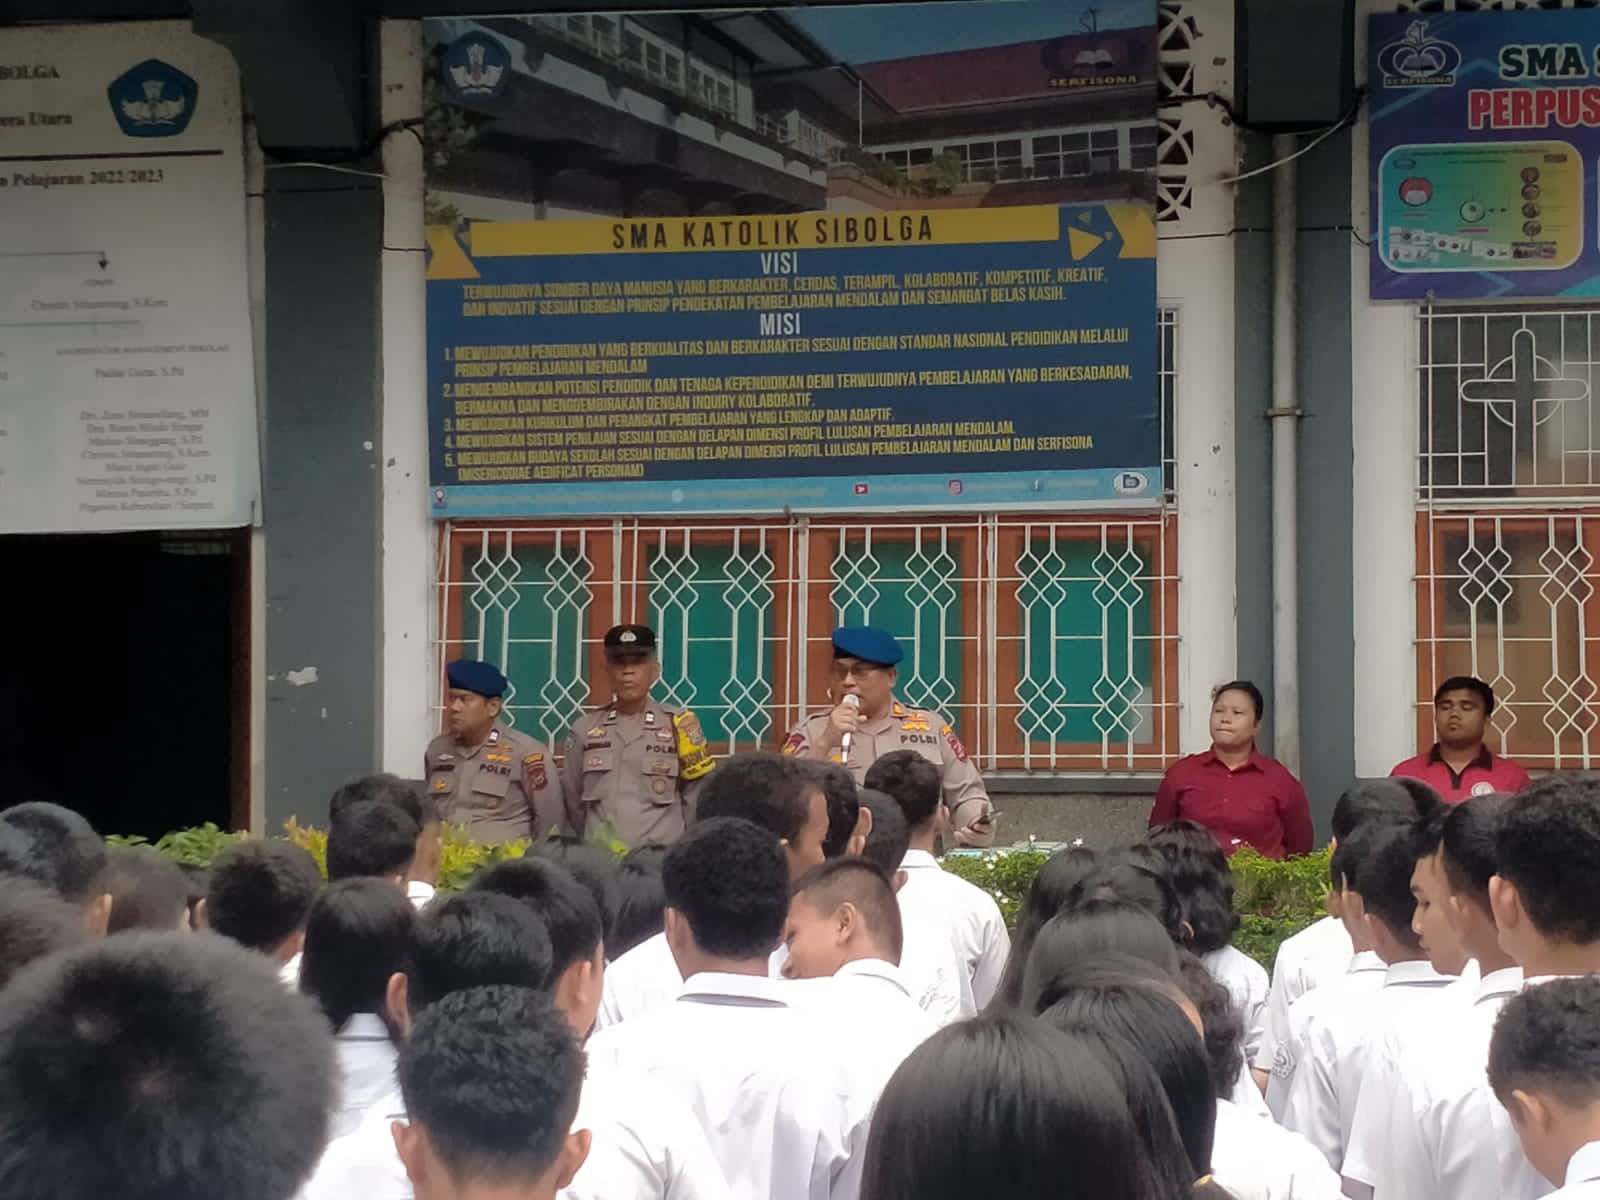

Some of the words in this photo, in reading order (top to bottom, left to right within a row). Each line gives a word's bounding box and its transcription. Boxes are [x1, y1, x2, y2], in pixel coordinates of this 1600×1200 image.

[1499, 44, 1588, 79] SMA
[1469, 88, 1600, 129] PERPUS
[613, 222, 667, 249] SMA
[683, 219, 799, 247] KATOLIK
[815, 215, 932, 244] SIBOLGA
[761, 251, 798, 274] VISI
[676, 279, 705, 294] YANG
[836, 291, 899, 307] MENDALAM
[902, 289, 925, 305] DAN
[927, 288, 988, 304] SEMANGAT
[991, 286, 1026, 302] BELAS
[760, 312, 801, 336] MISI
[706, 340, 729, 355] DAN
[731, 338, 810, 355] BERKARAKTER
[812, 337, 851, 352] SESUAI
[853, 336, 897, 351] DENGAN
[899, 334, 951, 350] STANDAR
[953, 332, 1008, 348] NASIONAL
[1011, 330, 1077, 346] PENDIDIKAN
[1080, 328, 1129, 344] MELALUI
[654, 377, 677, 392] DAN
[681, 376, 722, 392] TENAGA
[725, 374, 804, 391] KEPENDIDIKAN
[806, 373, 834, 389] DEMI
[837, 371, 916, 389] TERWUJUDNYA
[919, 369, 1005, 386] PEMBELAJARAN
[1007, 367, 1037, 383] YANG
[749, 410, 777, 425] YANG
[778, 409, 825, 424] LENGKAP
[826, 408, 848, 422] DAN
[698, 427, 745, 443] DELAPAN
[747, 426, 788, 441] DIMENSI
[790, 424, 825, 440] PROFIL
[826, 423, 872, 438] LULUSAN
[874, 421, 952, 438] PEMBELAJARAN
[697, 444, 742, 460] DELAPAN
[744, 443, 785, 459] DIMENSI
[788, 442, 823, 458] PROFIL
[824, 441, 869, 457] LULUSAN
[872, 440, 951, 456] PEMBELAJARAN
[953, 438, 1011, 454] MENDALAM
[1013, 437, 1035, 452] DAN
[1037, 435, 1093, 451] SERFISONA
[900, 734, 938, 746] POLRI
[480, 763, 512, 776] POLRI
